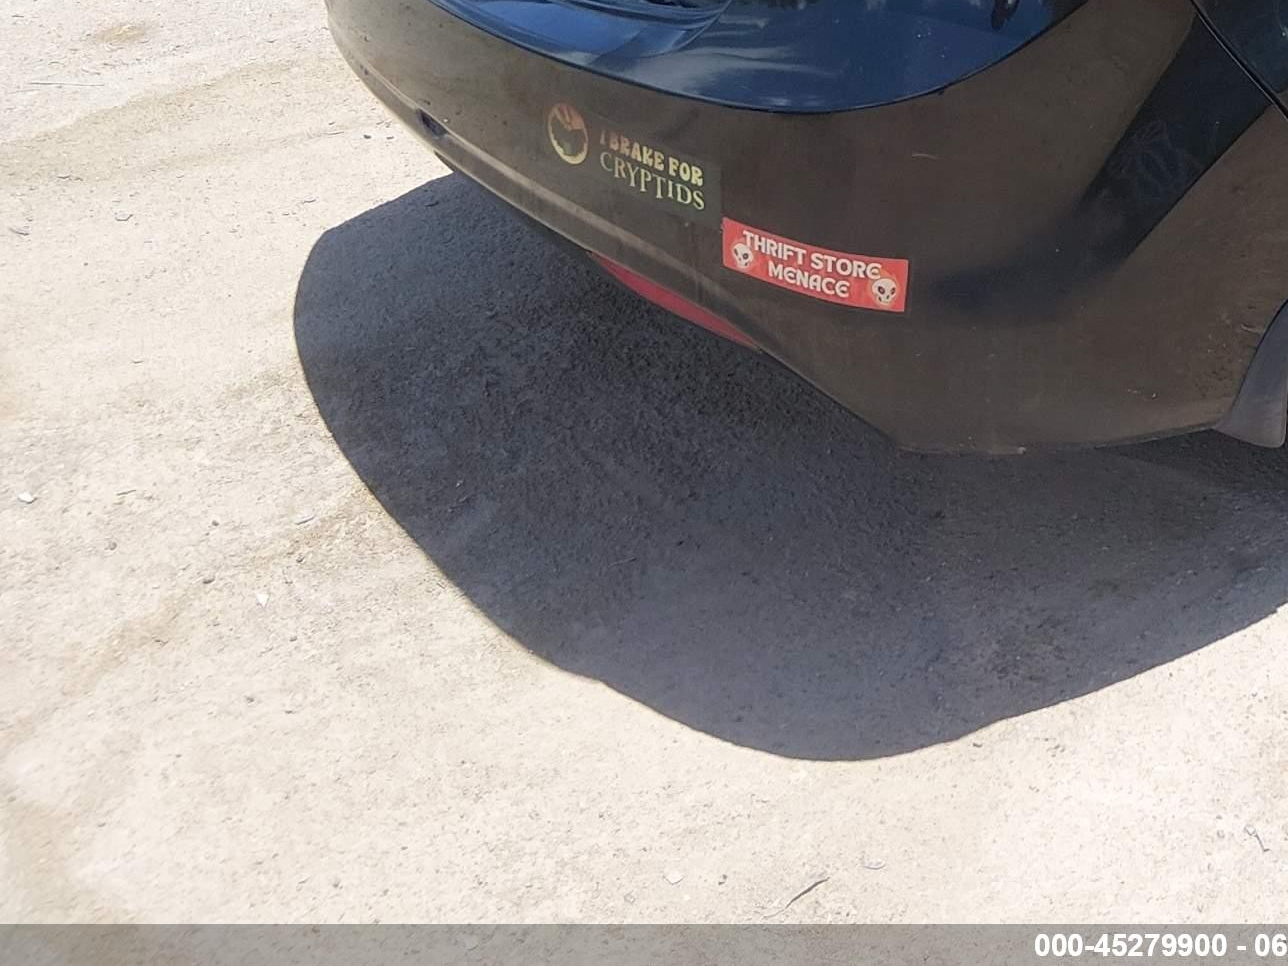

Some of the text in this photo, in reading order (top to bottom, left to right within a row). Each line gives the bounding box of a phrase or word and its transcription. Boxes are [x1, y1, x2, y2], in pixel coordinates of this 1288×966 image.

[600, 129, 704, 187] I BRAKE FOR
[600, 151, 705, 210] CRYPTIDS
[742, 229, 883, 280] THRIFT STORE
[768, 260, 851, 298] MENACE
